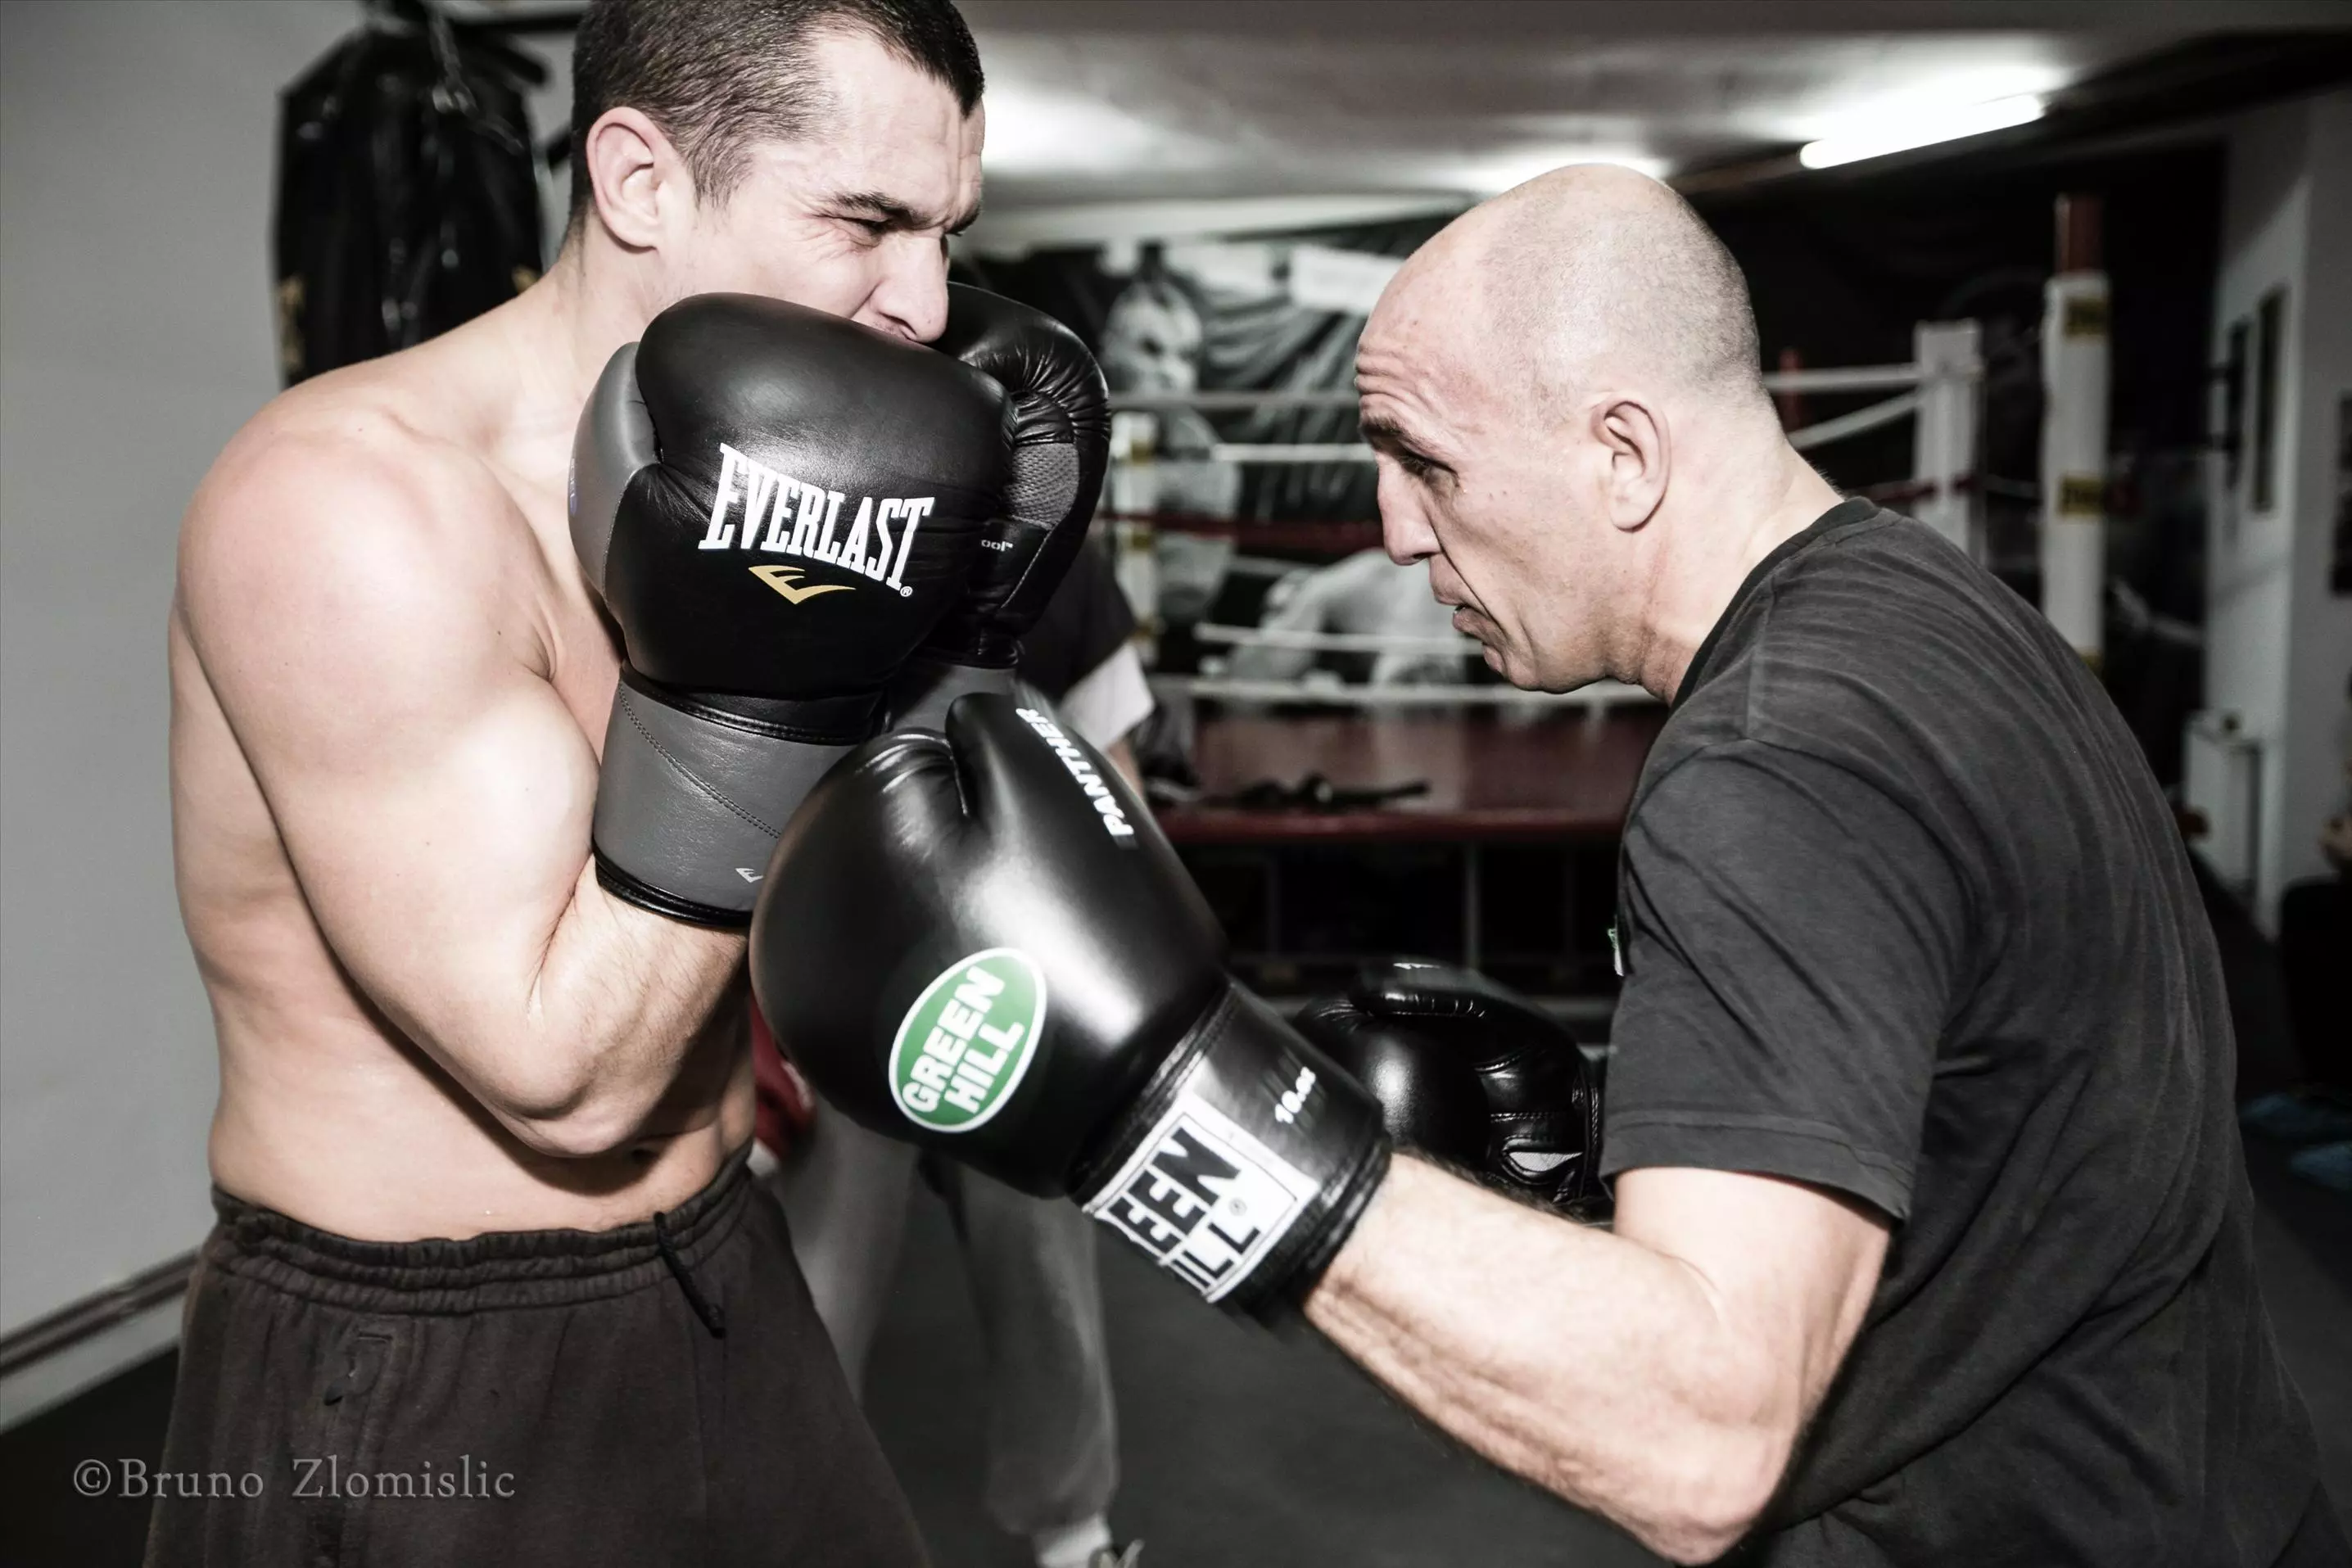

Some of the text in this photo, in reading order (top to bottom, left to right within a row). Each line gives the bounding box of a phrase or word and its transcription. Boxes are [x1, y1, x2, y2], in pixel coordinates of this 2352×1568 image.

[1015, 708, 1134, 836] PANTHER
[902, 965, 1005, 1112] GREEN
[943, 1022, 1025, 1114] HILL
